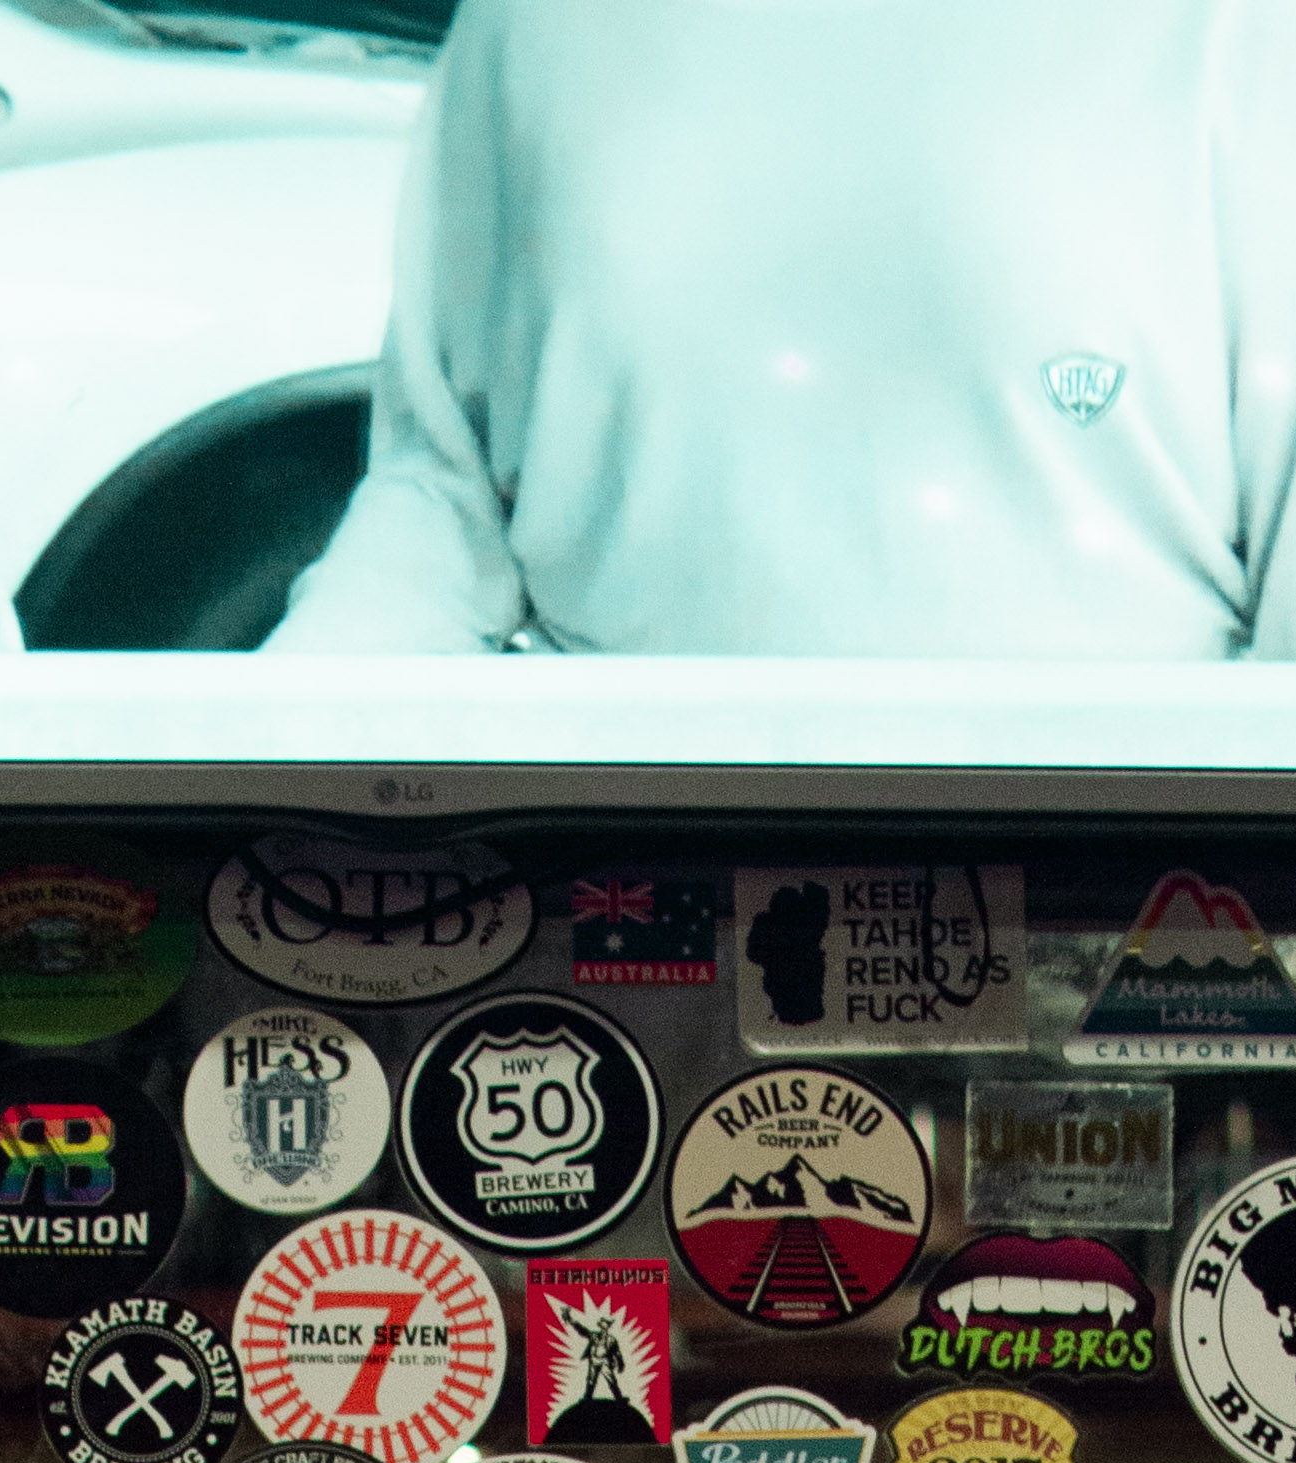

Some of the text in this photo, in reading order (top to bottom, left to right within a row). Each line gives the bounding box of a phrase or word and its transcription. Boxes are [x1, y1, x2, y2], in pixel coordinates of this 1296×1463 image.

[842, 880, 935, 911] KEEP
[843, 921, 973, 948] TAHOE
[845, 956, 1010, 986] RENO AS
[846, 994, 942, 1025] FUCK
[501, 1058, 549, 1076] HWY
[487, 1084, 576, 1143] 50
[713, 1079, 882, 1138] RAILS END
[778, 1118, 819, 1133] BEER
[758, 1132, 841, 1150] COMPANY
[482, 1171, 588, 1194] BREWERY
[1189, 1200, 1263, 1299] BIG
[287, 1324, 450, 1347] TRACK SEVEN
[910, 1328, 1153, 1371] DUTCH BROS
[907, 1410, 1064, 1463] RESERVE
